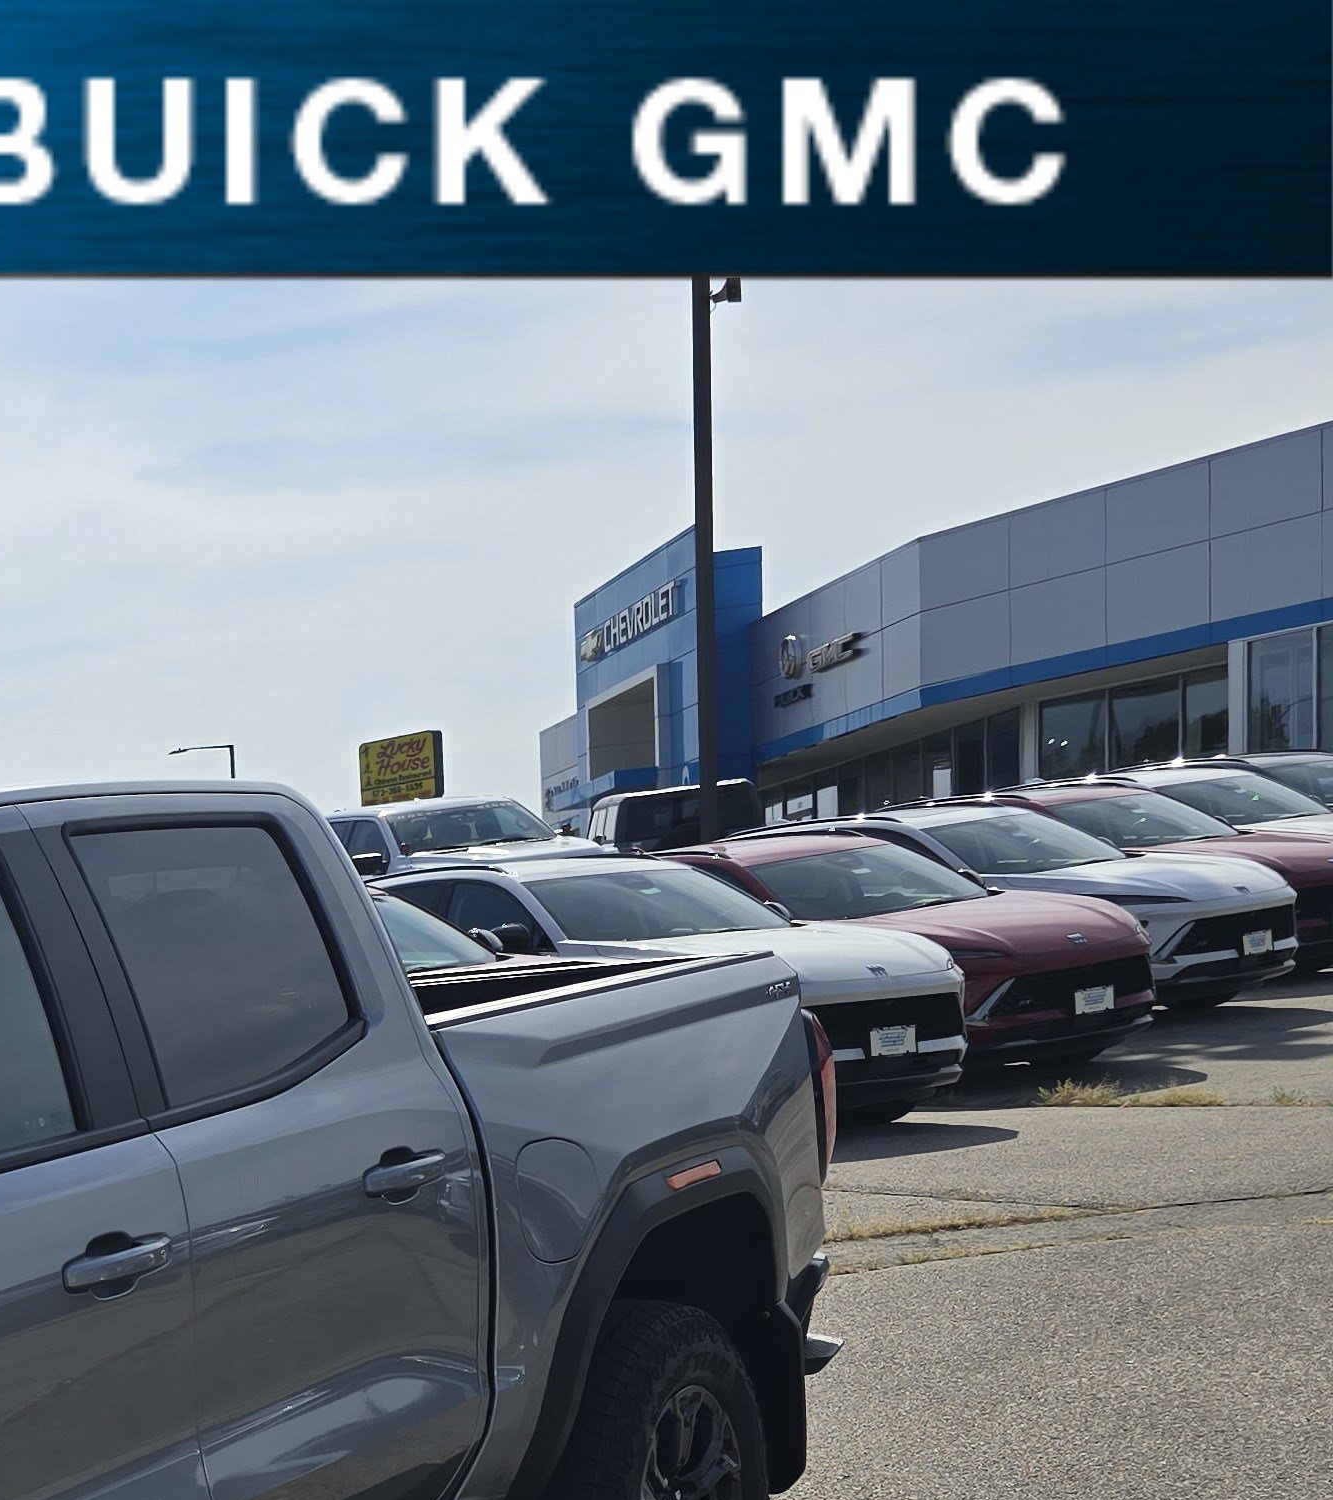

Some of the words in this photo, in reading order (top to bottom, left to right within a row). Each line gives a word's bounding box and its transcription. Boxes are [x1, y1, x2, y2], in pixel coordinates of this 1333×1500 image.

[603, 580, 676, 653] CHEVROLET
[806, 632, 860, 672] GMC
[376, 738, 427, 759] Lucky
[376, 756, 430, 777] House
